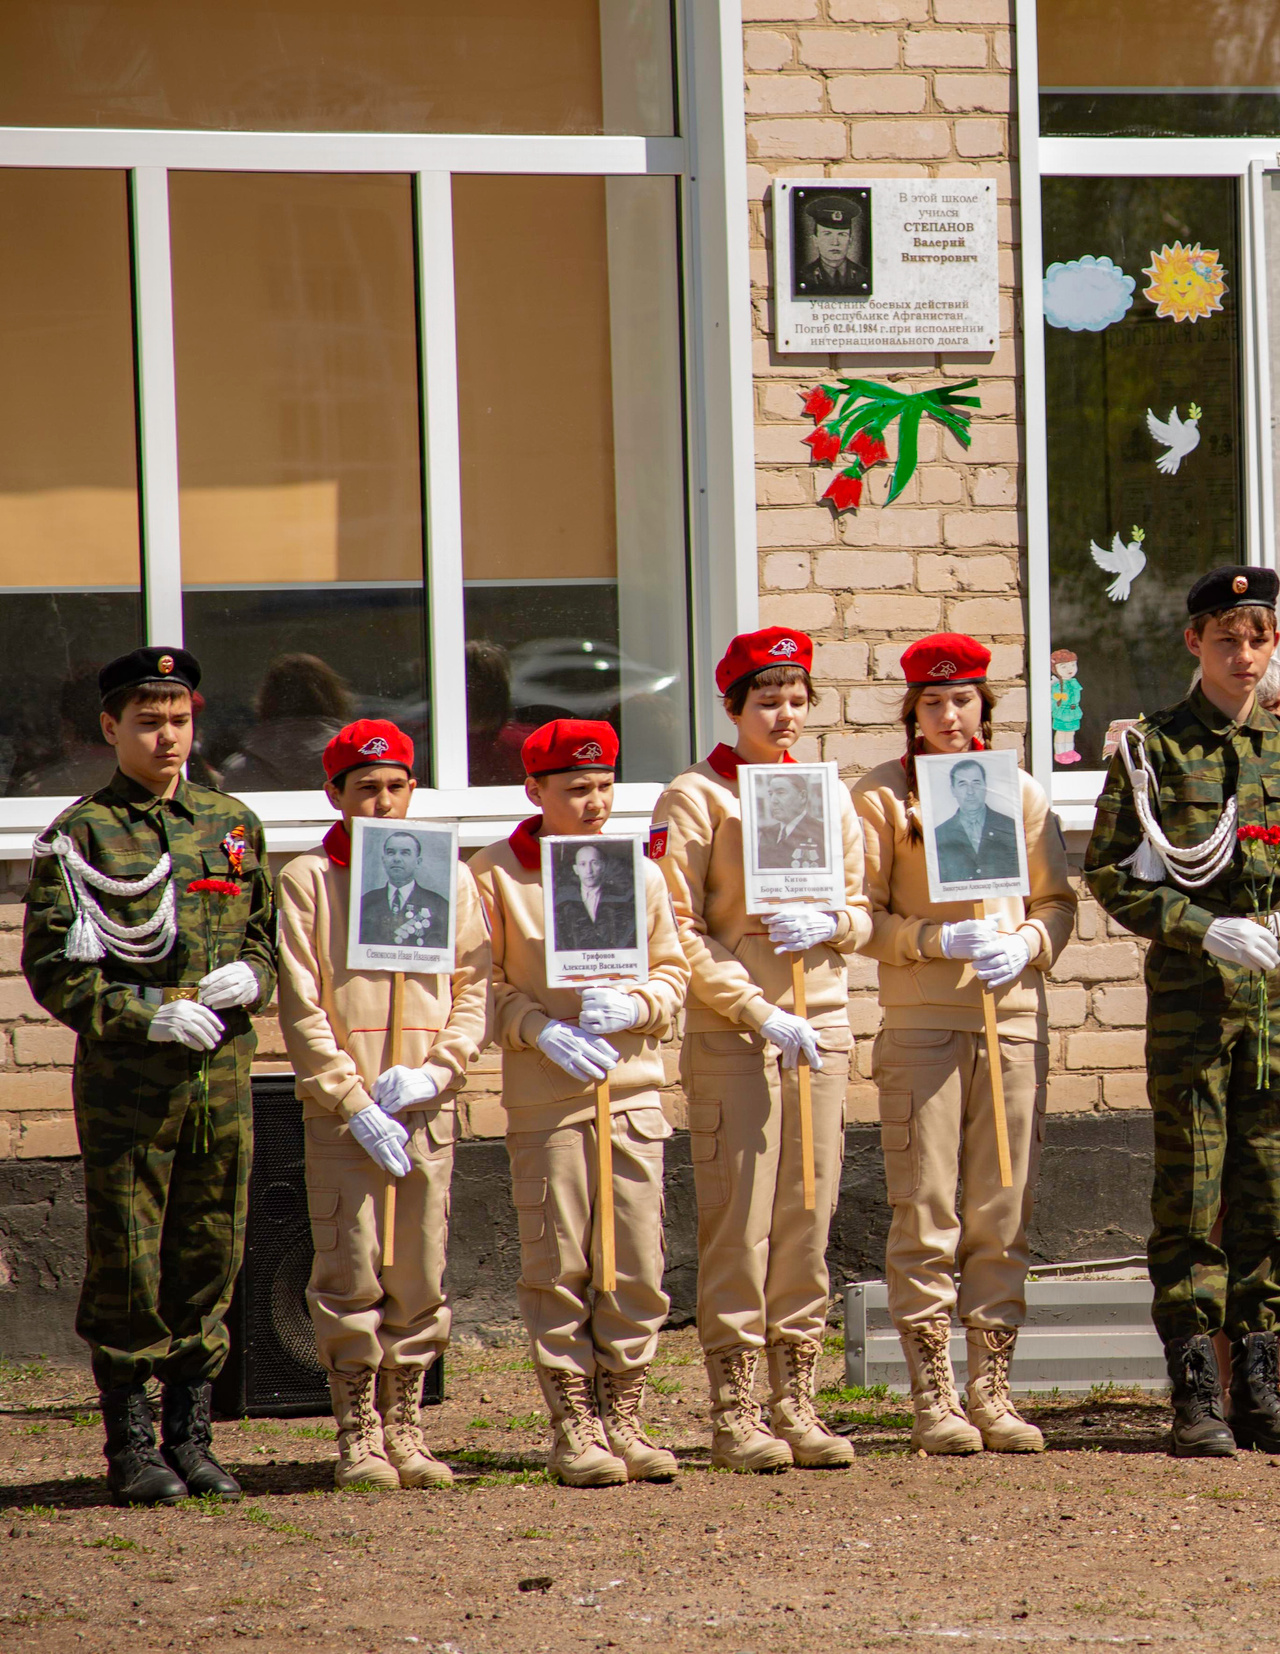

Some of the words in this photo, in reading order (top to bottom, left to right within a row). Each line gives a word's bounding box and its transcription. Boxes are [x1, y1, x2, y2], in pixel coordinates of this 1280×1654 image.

[899, 193, 907, 203] В
[912, 192, 938, 203] этой
[942, 194, 979, 203] школе
[918, 208, 959, 220] учился
[904, 222, 975, 232] СТЕПАНОВ
[913, 237, 966, 249] Валерий
[901, 253, 978, 265] Викторович
[810, 300, 866, 312] Участник
[869, 300, 911, 310] боевых
[915, 300, 969, 311] действий
[822, 312, 890, 323] республике
[893, 312, 967, 323] Афганистан.
[795, 324, 830, 334] Погиб
[833, 324, 878, 334] 02.04.1984
[915, 326, 984, 334] исполнении
[810, 337, 934, 346] интернационального
[937, 337, 969, 347] долга
[761, 886, 783, 894] Борис
[785, 886, 833, 894] Харитонович
[367, 949, 396, 960] Сенокосов
[398, 950, 413, 960] Иван
[414, 951, 441, 962] Иванович
[582, 952, 615, 962] Трифонов
[562, 964, 598, 972] Александр
[599, 962, 638, 970] Васильевич
